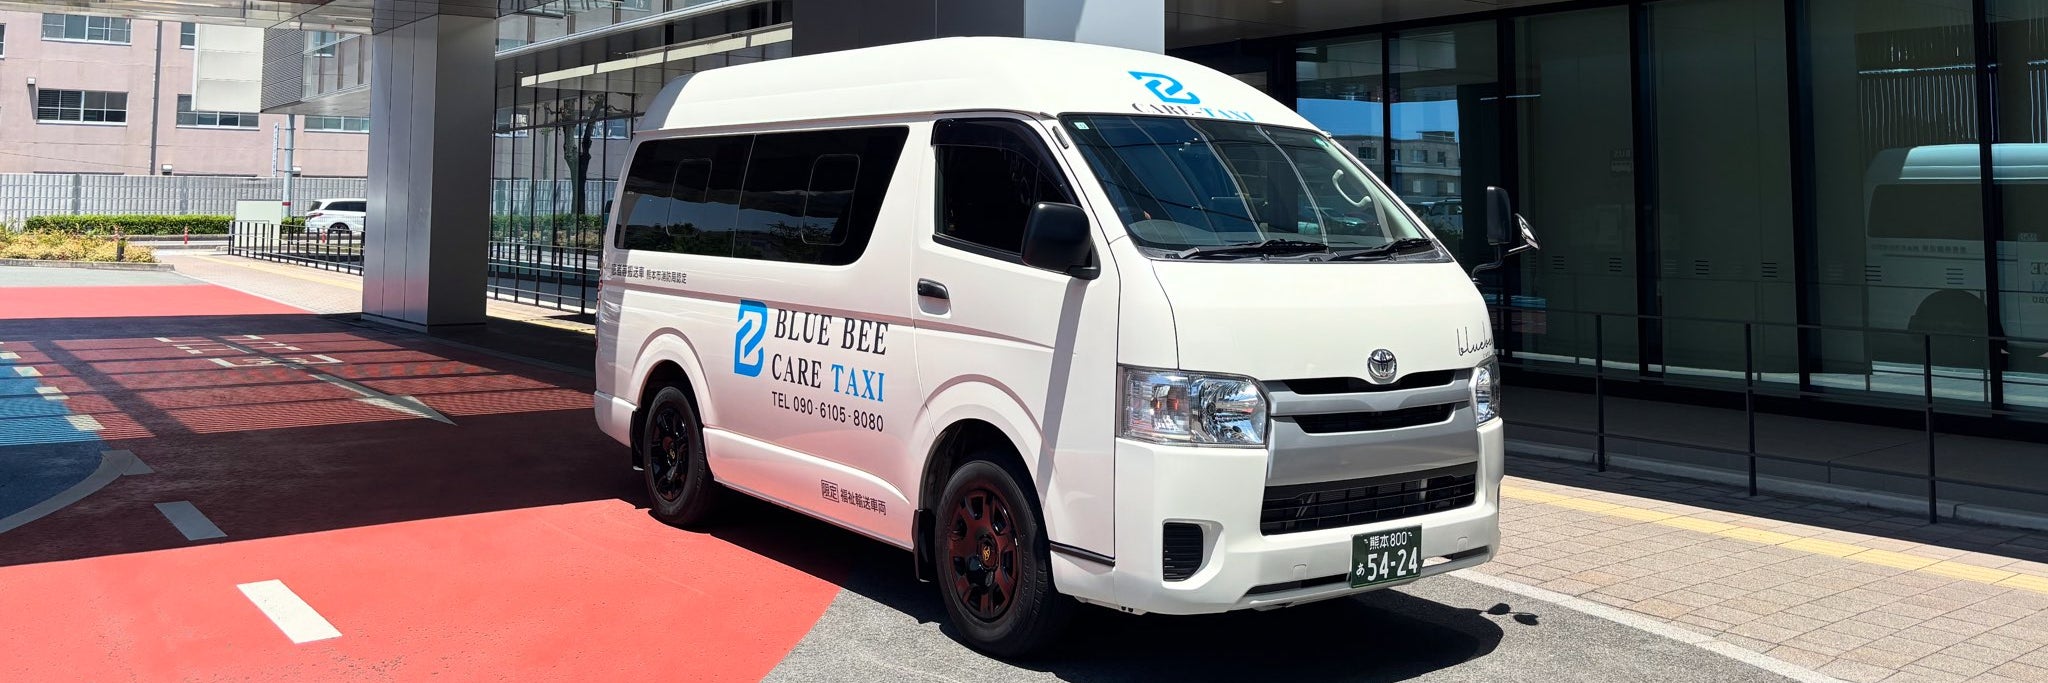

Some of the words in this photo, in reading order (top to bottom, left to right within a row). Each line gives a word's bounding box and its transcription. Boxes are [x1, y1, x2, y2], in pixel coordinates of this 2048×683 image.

[774, 308, 832, 346] BLUE
[841, 318, 889, 355] BEE
[771, 353, 822, 388] CARE
[831, 364, 885, 402] TAXI
[771, 391, 790, 410] TEL
[793, 396, 884, 432] 090-6105-8080
[840, 488, 887, 516] 福祉輸送車両
[1356, 562, 1365, 576] あ
[1367, 547, 1418, 581] 54-24
